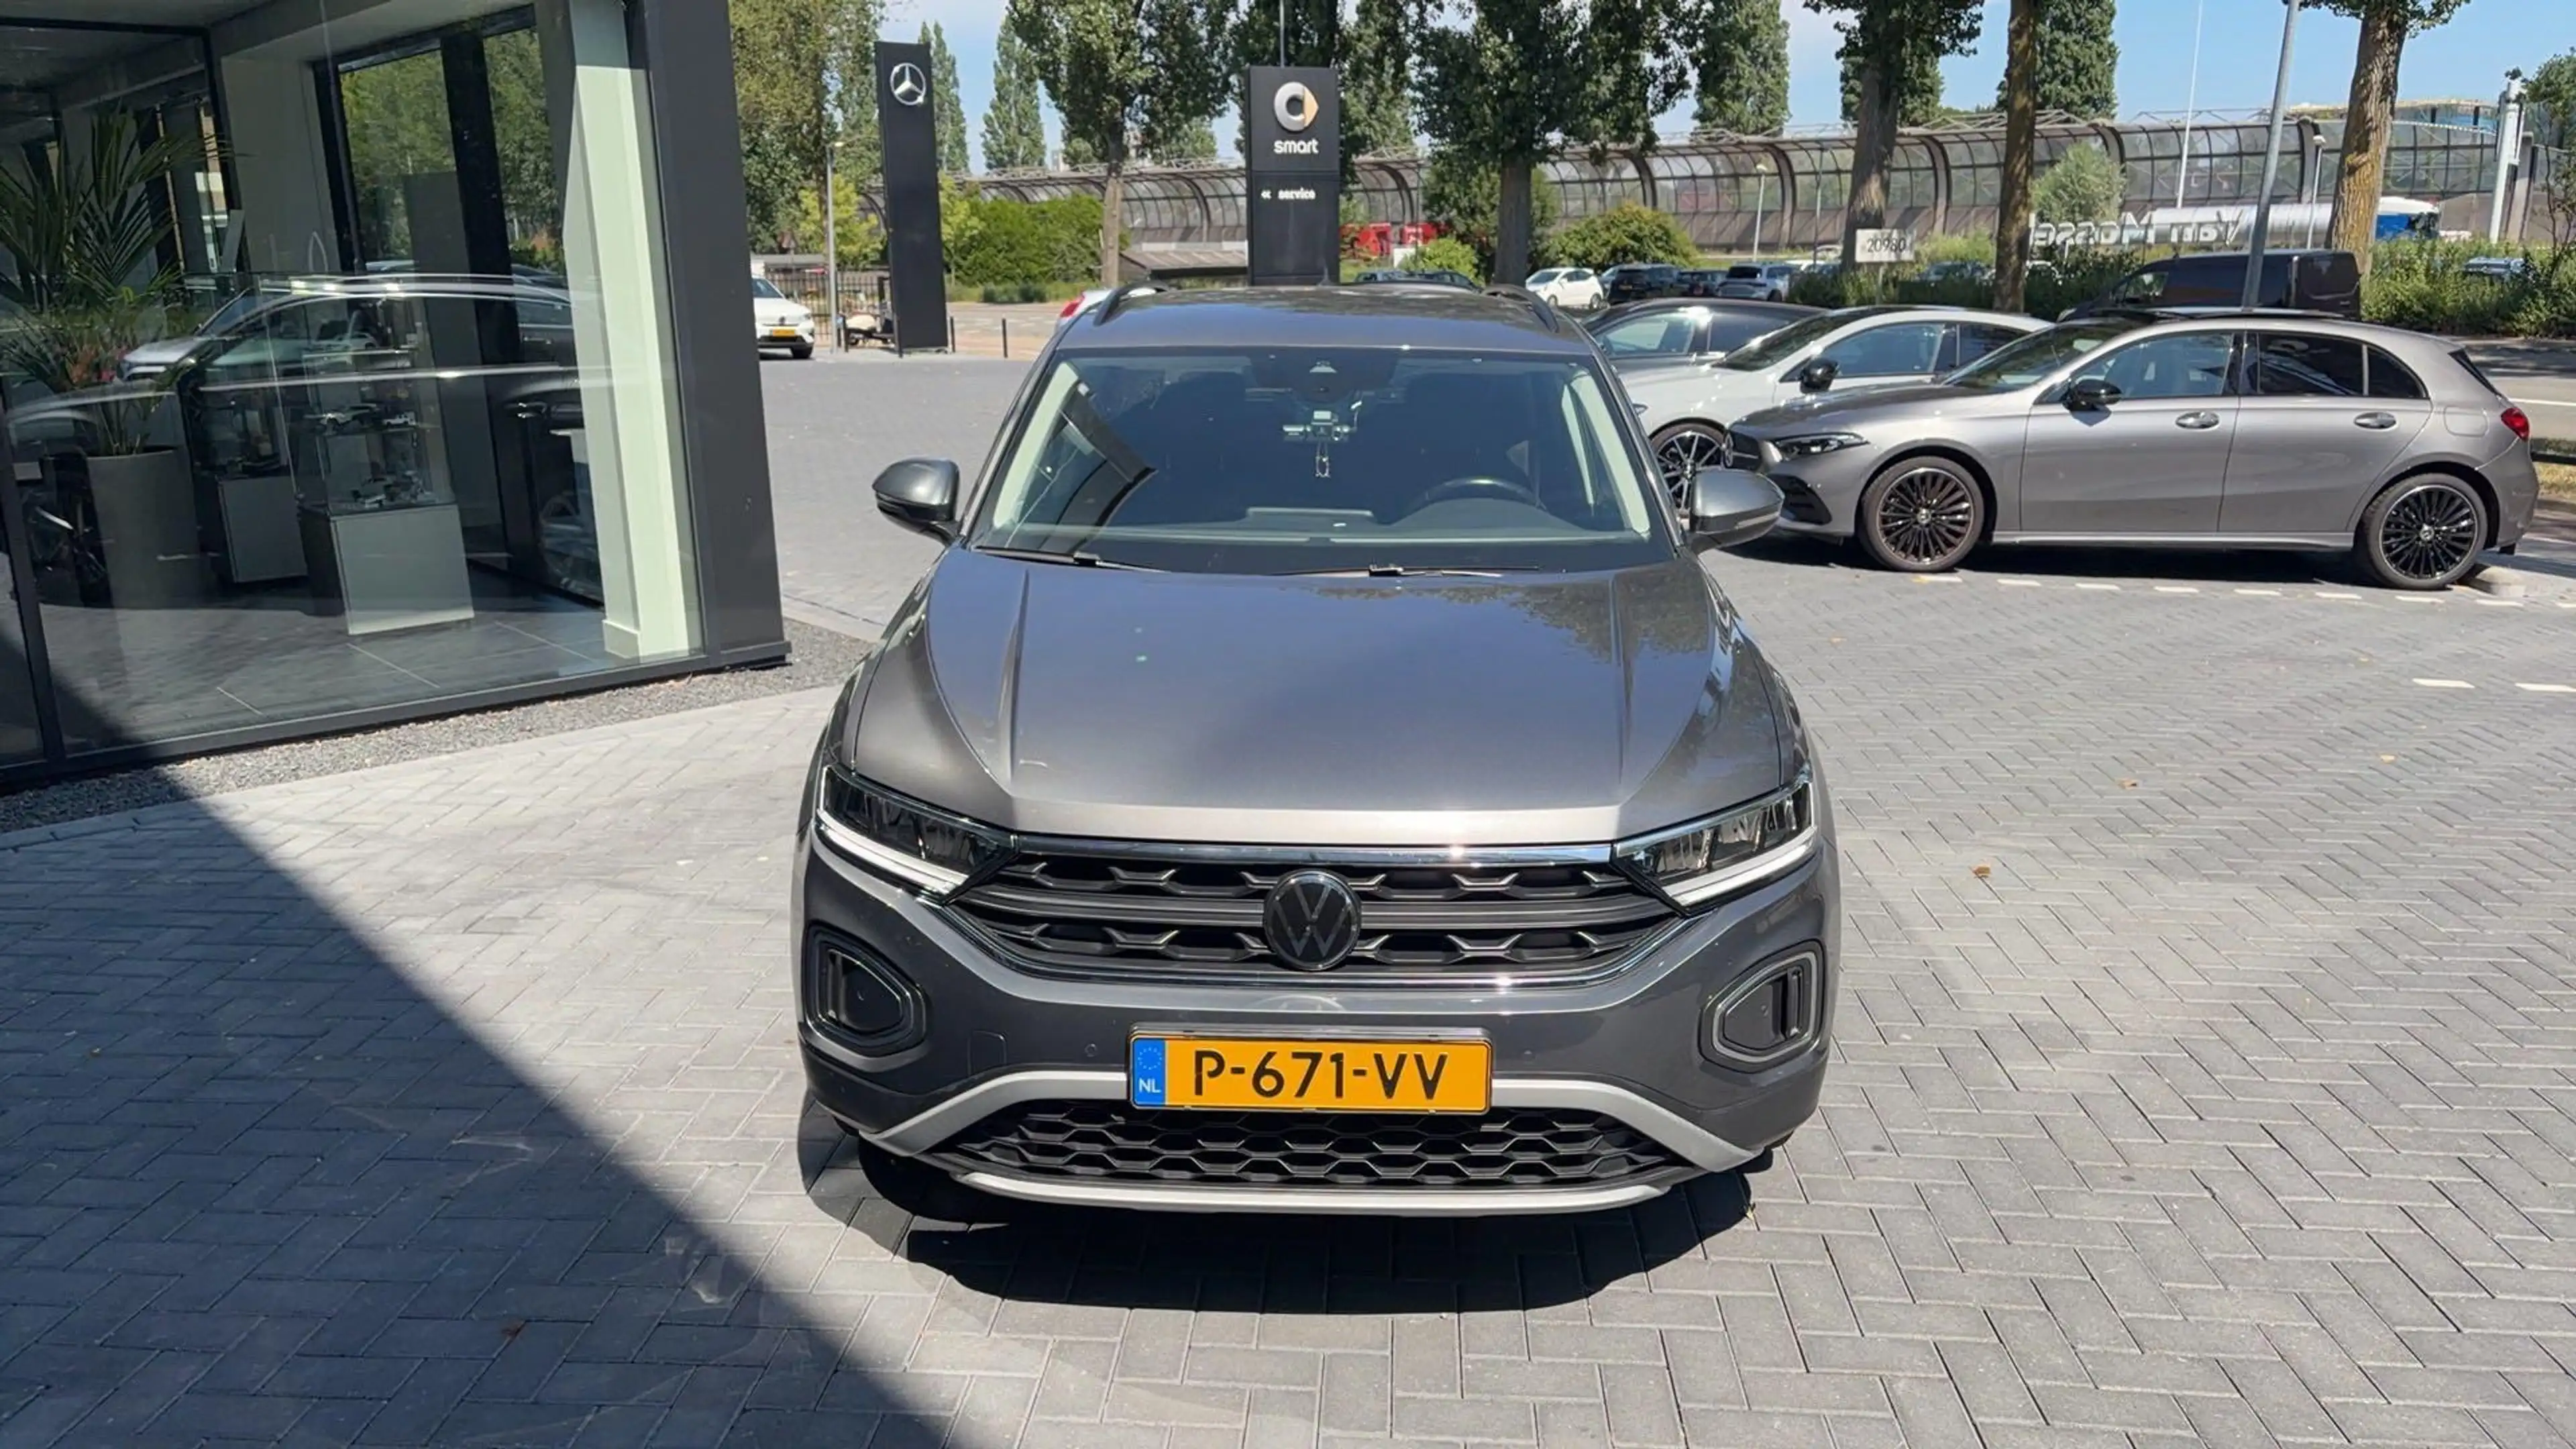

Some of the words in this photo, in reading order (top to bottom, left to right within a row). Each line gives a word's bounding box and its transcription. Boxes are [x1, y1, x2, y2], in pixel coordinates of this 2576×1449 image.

[1274, 138, 1319, 154] smart
[1277, 186, 1316, 200] service
[1867, 237, 1906, 253] 20980
[1270, 876, 1352, 961] VW
[1194, 1050, 1448, 1101] P-671-VV
[1139, 1077, 1162, 1093] NL
